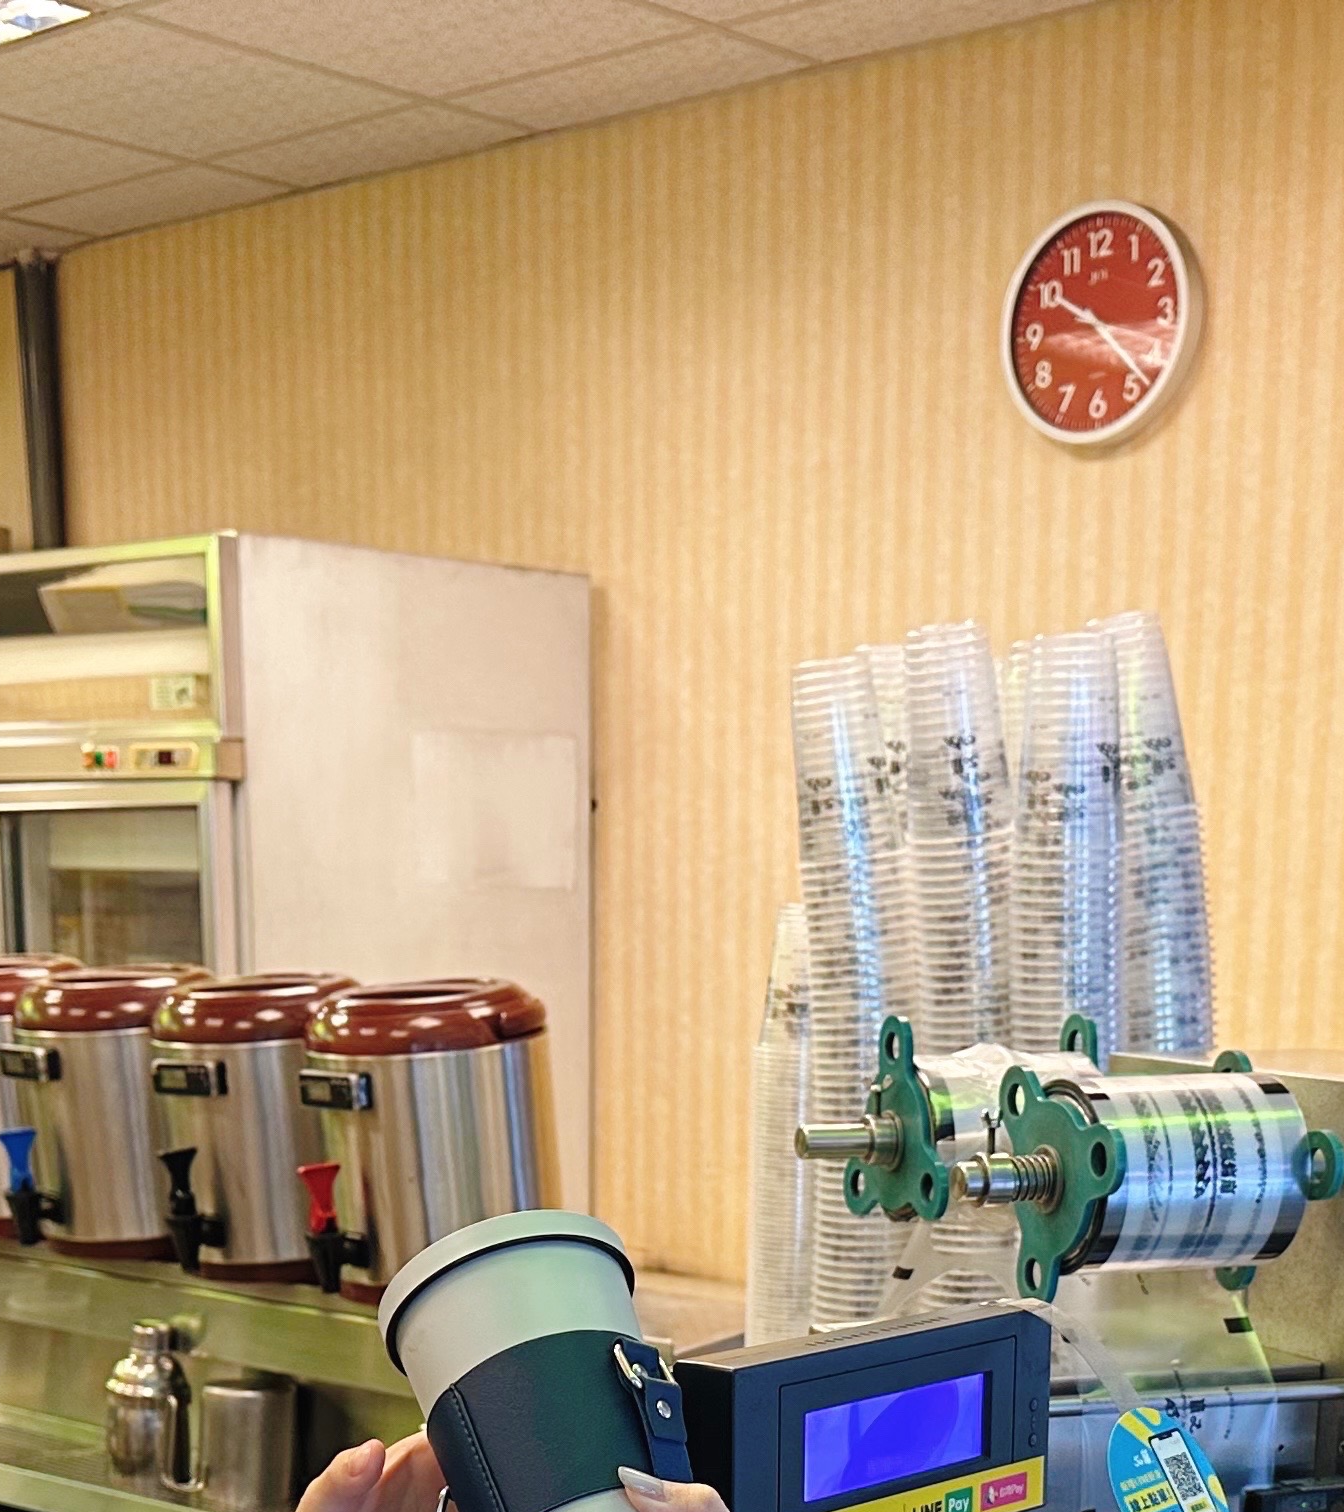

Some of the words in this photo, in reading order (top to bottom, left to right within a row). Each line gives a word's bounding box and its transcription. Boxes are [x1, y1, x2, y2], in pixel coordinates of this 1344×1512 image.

[1088, 229, 1113, 258] 12
[1128, 234, 1139, 262] 1
[1061, 247, 1081, 275] 11
[1147, 259, 1165, 286] 2
[1040, 280, 1063, 309] 10
[1158, 297, 1175, 326] 3
[1026, 323, 1044, 350] 9
[1035, 360, 1052, 388] 8
[1122, 373, 1141, 402] 5
[1058, 384, 1076, 414] 7
[1088, 389, 1107, 418] 6
